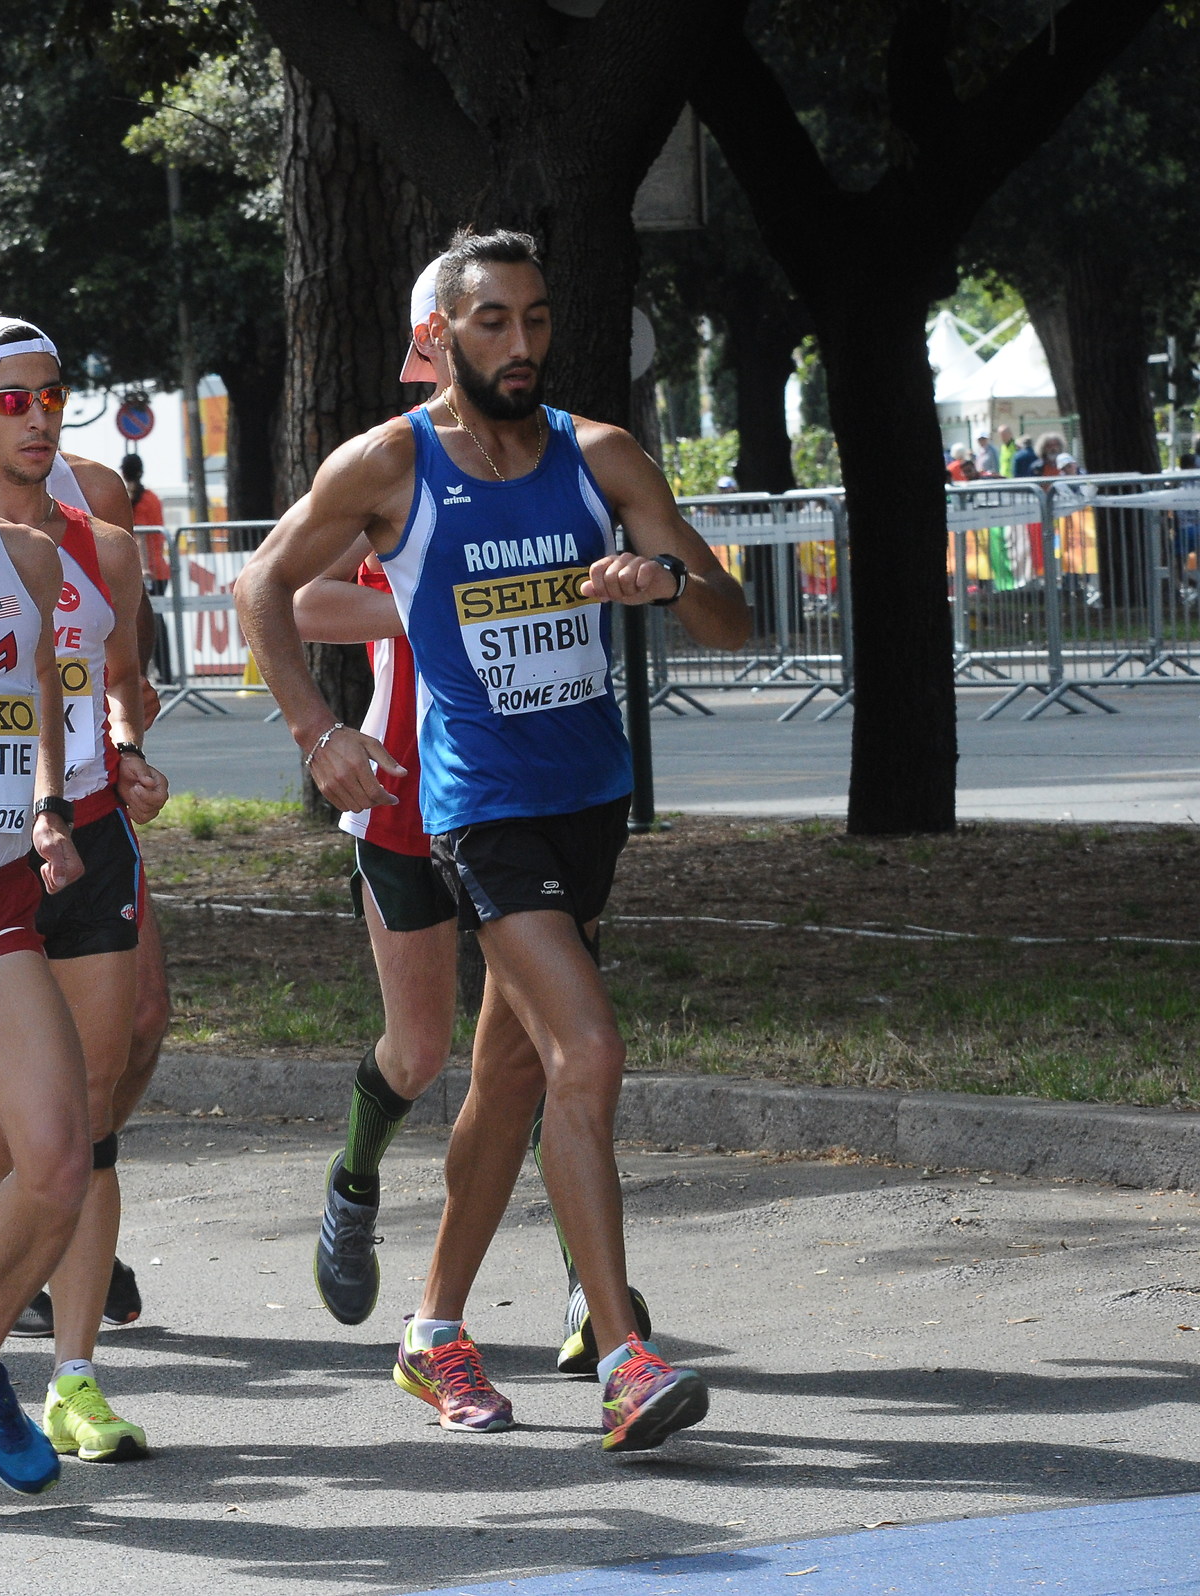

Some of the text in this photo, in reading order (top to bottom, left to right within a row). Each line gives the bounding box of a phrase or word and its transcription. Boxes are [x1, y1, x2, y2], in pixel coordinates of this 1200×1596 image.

[443, 495, 471, 505] erima
[463, 533, 579, 573] ROMANIA
[479, 613, 589, 661] STIRBU
[497, 676, 593, 711] ROME 2016
